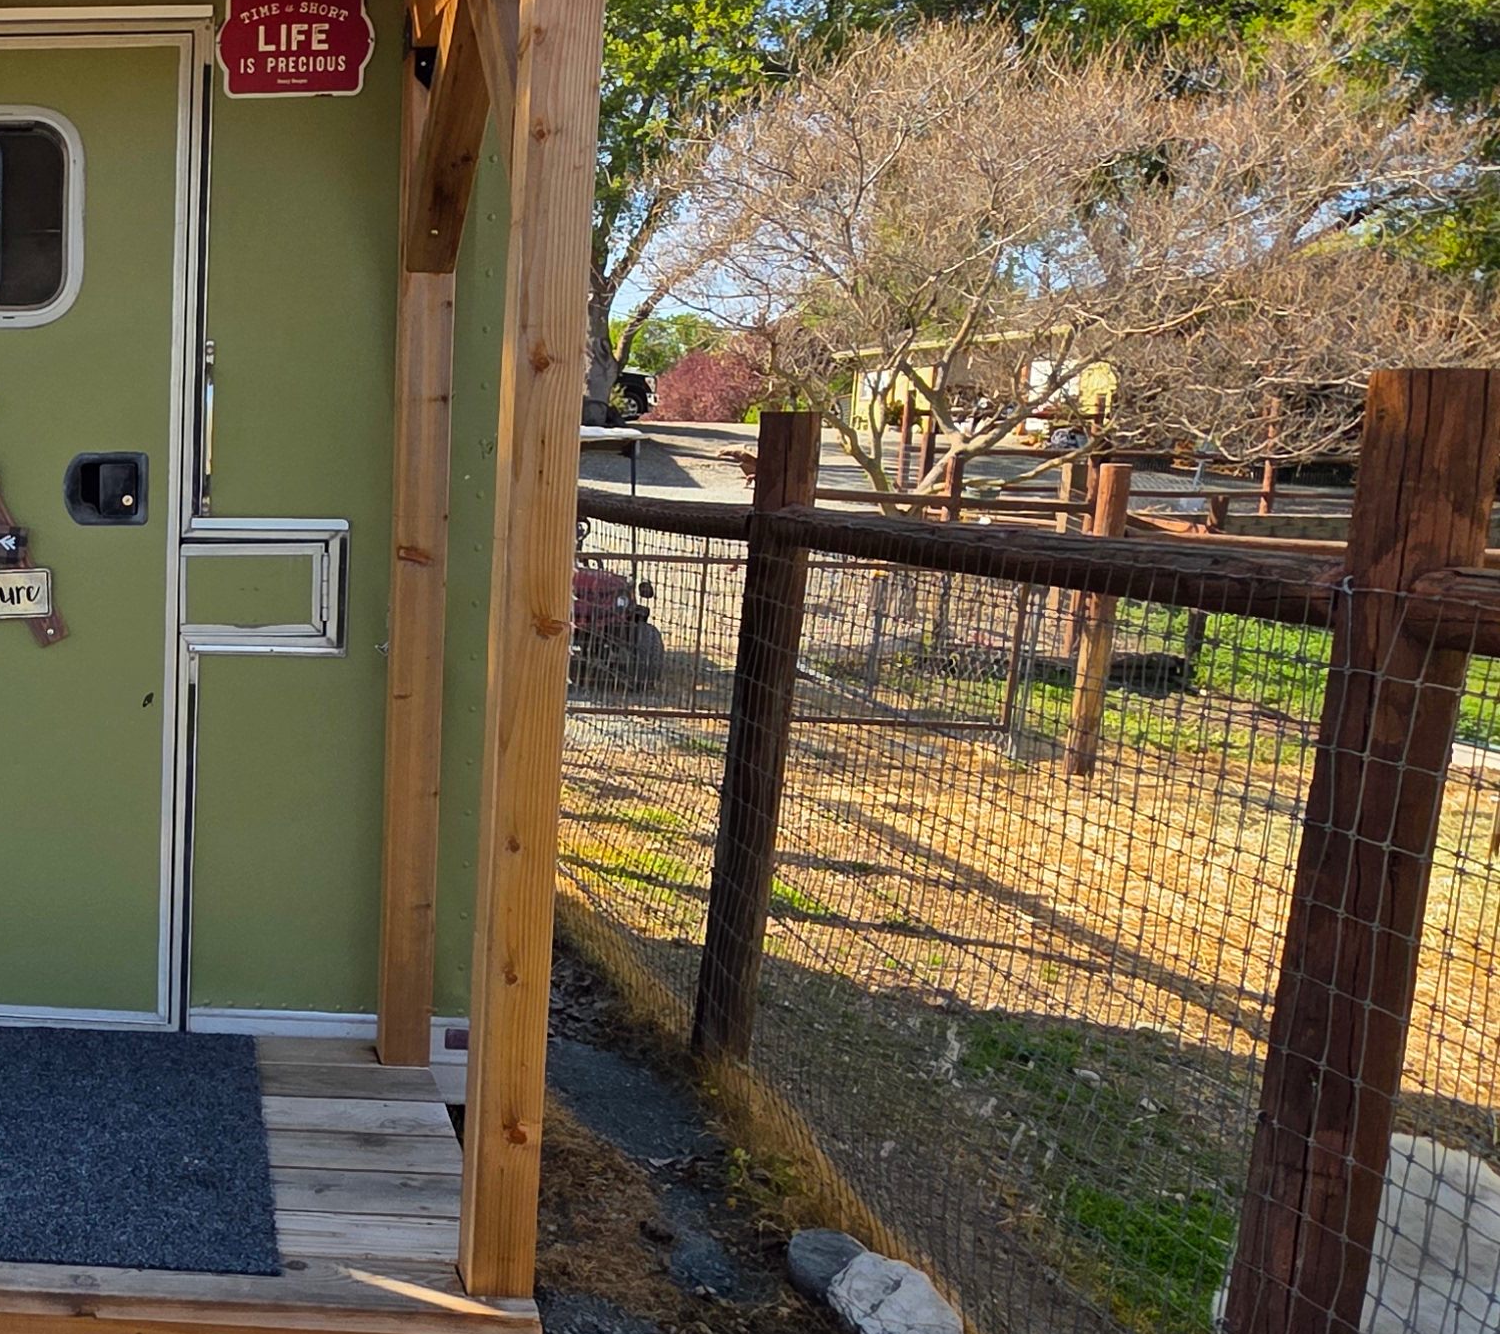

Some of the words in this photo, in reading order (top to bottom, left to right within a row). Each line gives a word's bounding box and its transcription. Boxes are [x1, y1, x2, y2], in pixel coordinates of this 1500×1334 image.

[240, 2, 280, 24] TIME
[299, 1, 349, 22] SHORT
[258, 23, 330, 52] LIFE
[240, 58, 256, 74] IS
[267, 55, 346, 73] PRECIOUS
